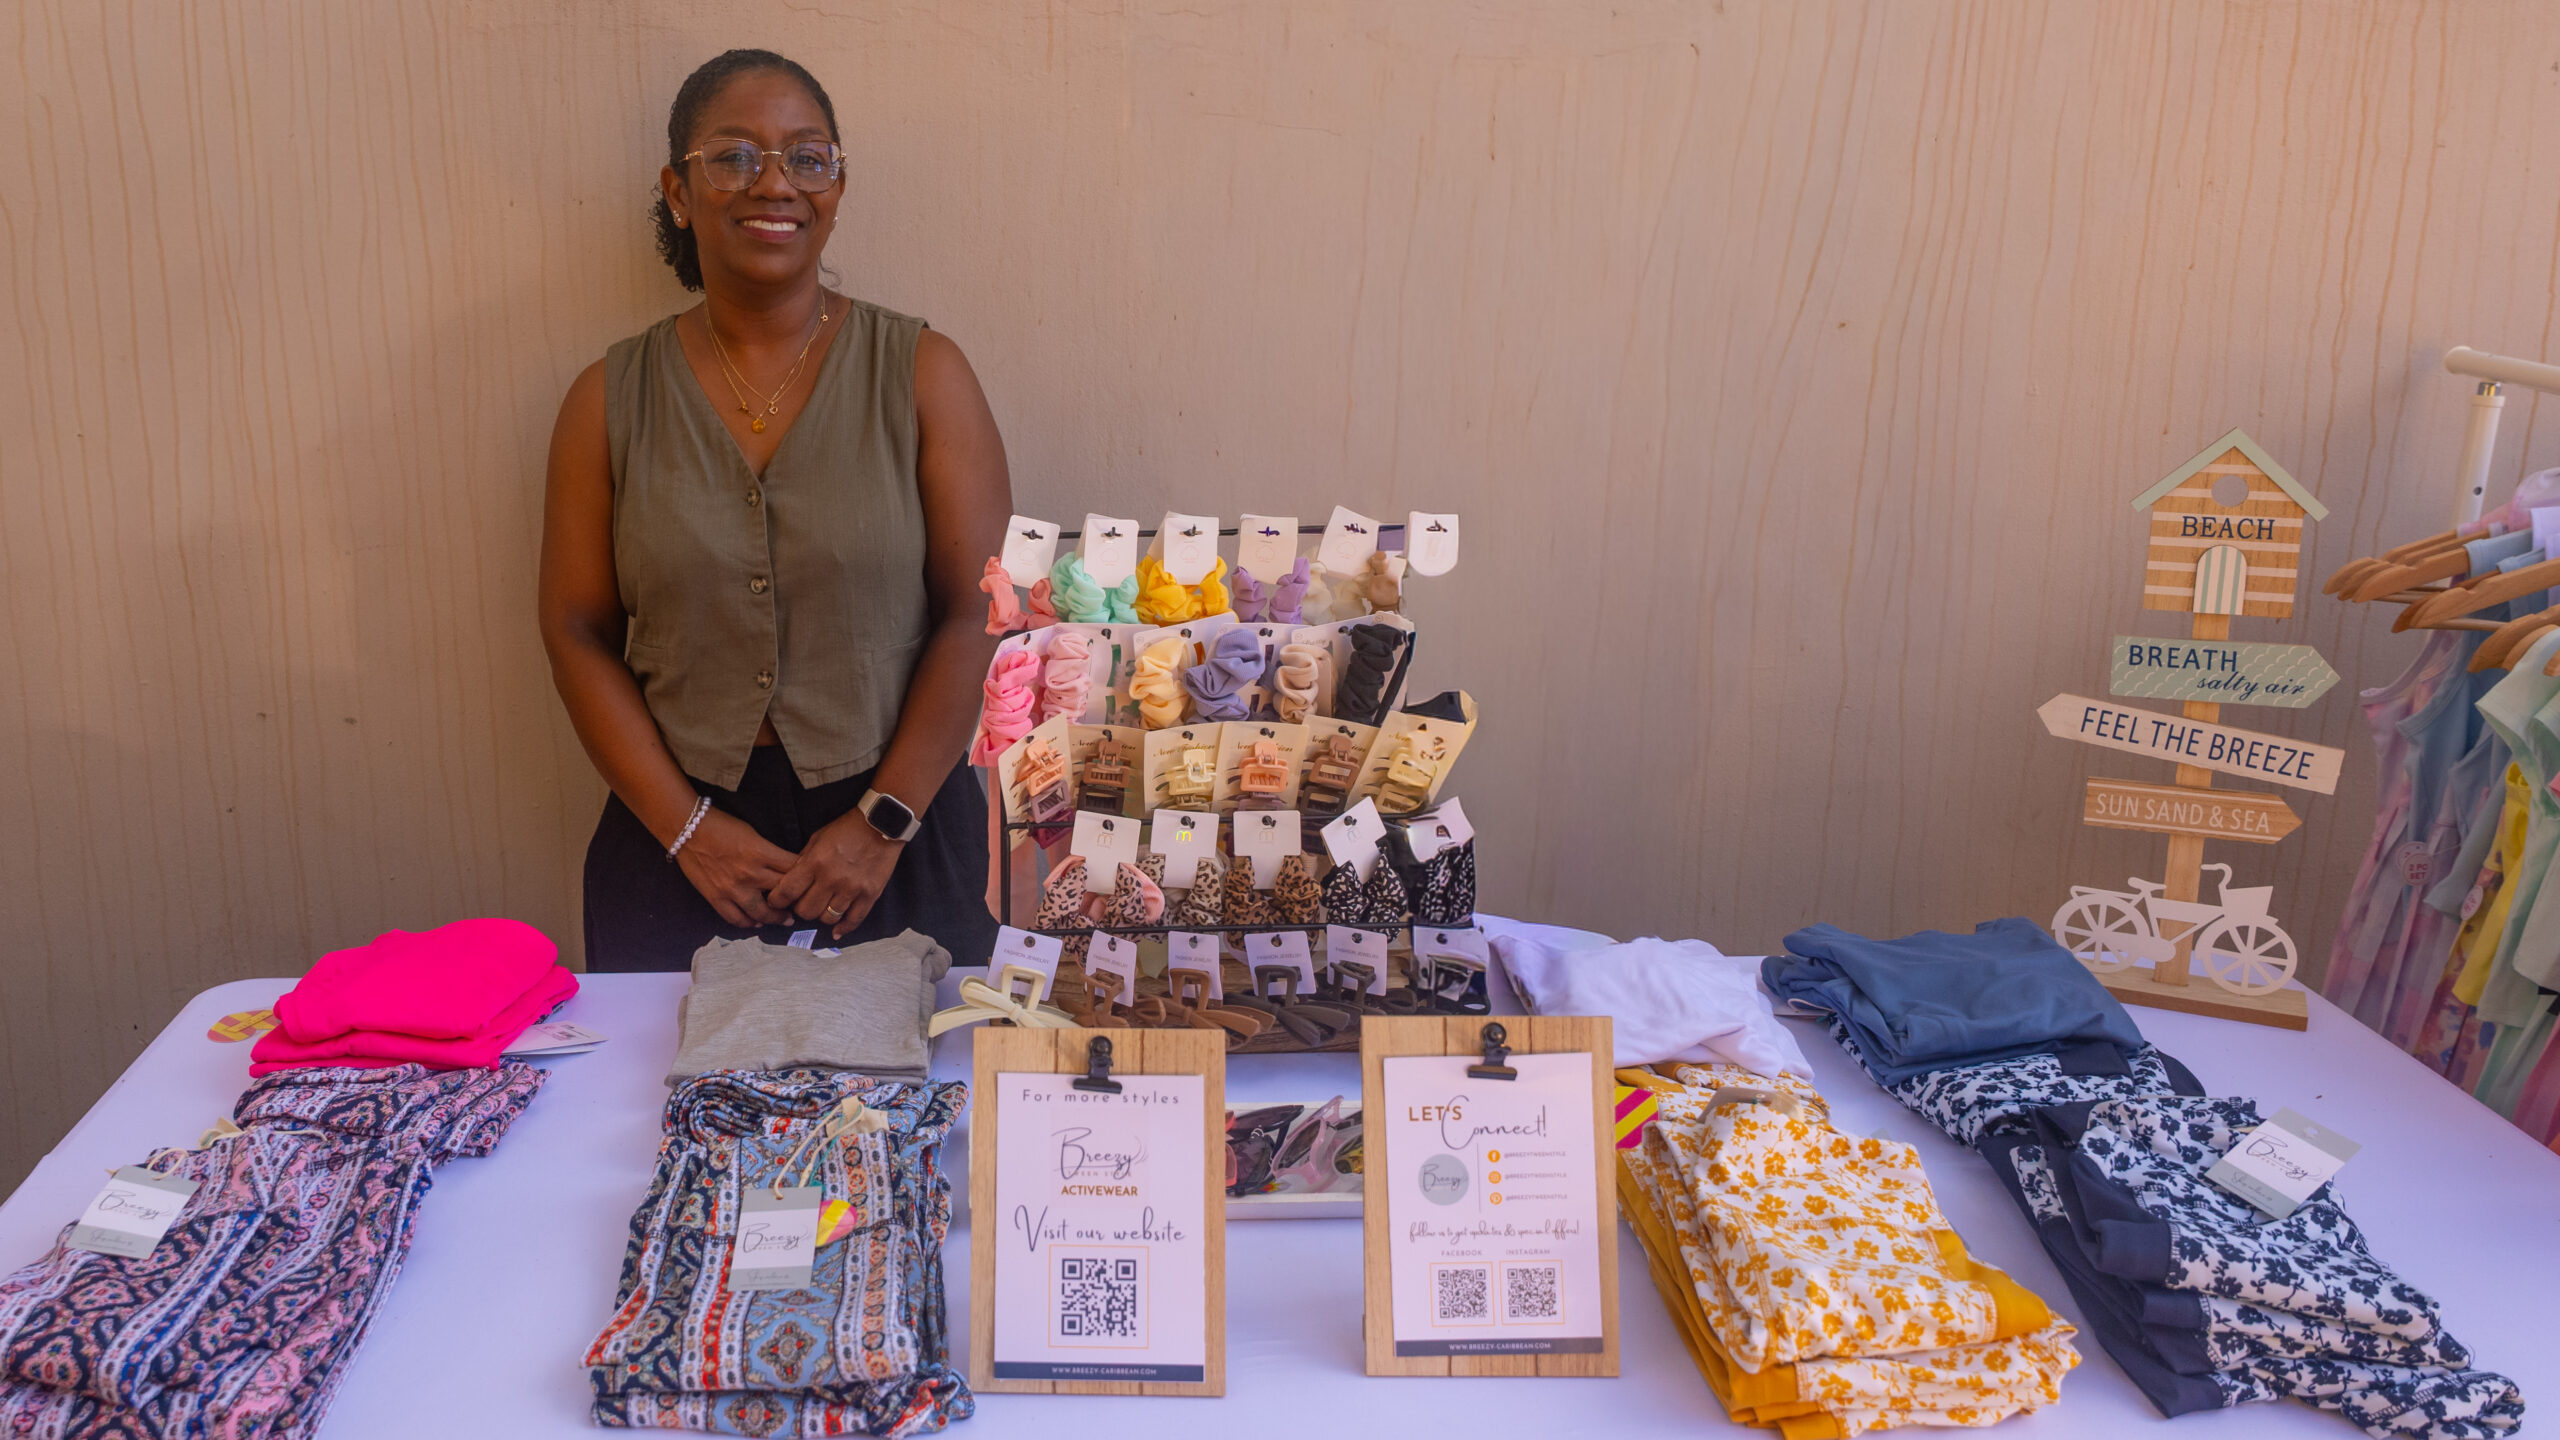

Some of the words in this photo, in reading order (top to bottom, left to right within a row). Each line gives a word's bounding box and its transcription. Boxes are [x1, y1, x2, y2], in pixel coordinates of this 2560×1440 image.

[2181, 515, 2275, 540] BEACH
[2128, 645, 2238, 672] BREATH
[2196, 671, 2259, 701] salty
[2264, 678, 2306, 695] air
[2080, 706, 2140, 744] FEEL
[2151, 720, 2203, 756] THE
[2208, 733, 2315, 780] BREEZE
[2095, 793, 2140, 818] SUN
[2144, 799, 2203, 825] SAND
[2208, 805, 2224, 829] &
[2229, 808, 2271, 833] SEA
[1022, 1089, 1052, 1102] For
[1064, 1092, 1110, 1103] more
[1122, 1091, 1179, 1106] styles
[1408, 1105, 1463, 1122] LET'S
[1441, 1094, 1547, 1150] Connect!
[1051, 1126, 1138, 1180] Breezy
[2246, 1131, 2310, 1181] Breezy
[1061, 1185, 1138, 1196] ACTIVEWEAR
[1421, 1163, 1462, 1192] Breezy
[740, 1222, 802, 1253] Breezy
[1014, 1204, 1069, 1252] Visit
[1076, 1229, 1104, 1241] our
[1113, 1206, 1186, 1242] website
[1409, 1221, 1436, 1242] follow
[1449, 1226, 1468, 1245] get
[1470, 1219, 1502, 1240] updates
[1503, 1223, 1516, 1237] &
[1517, 1219, 1551, 1240] special
[1441, 1249, 1483, 1257] FACEBOOK
[1505, 1248, 1551, 1256] INSTAGRAM
